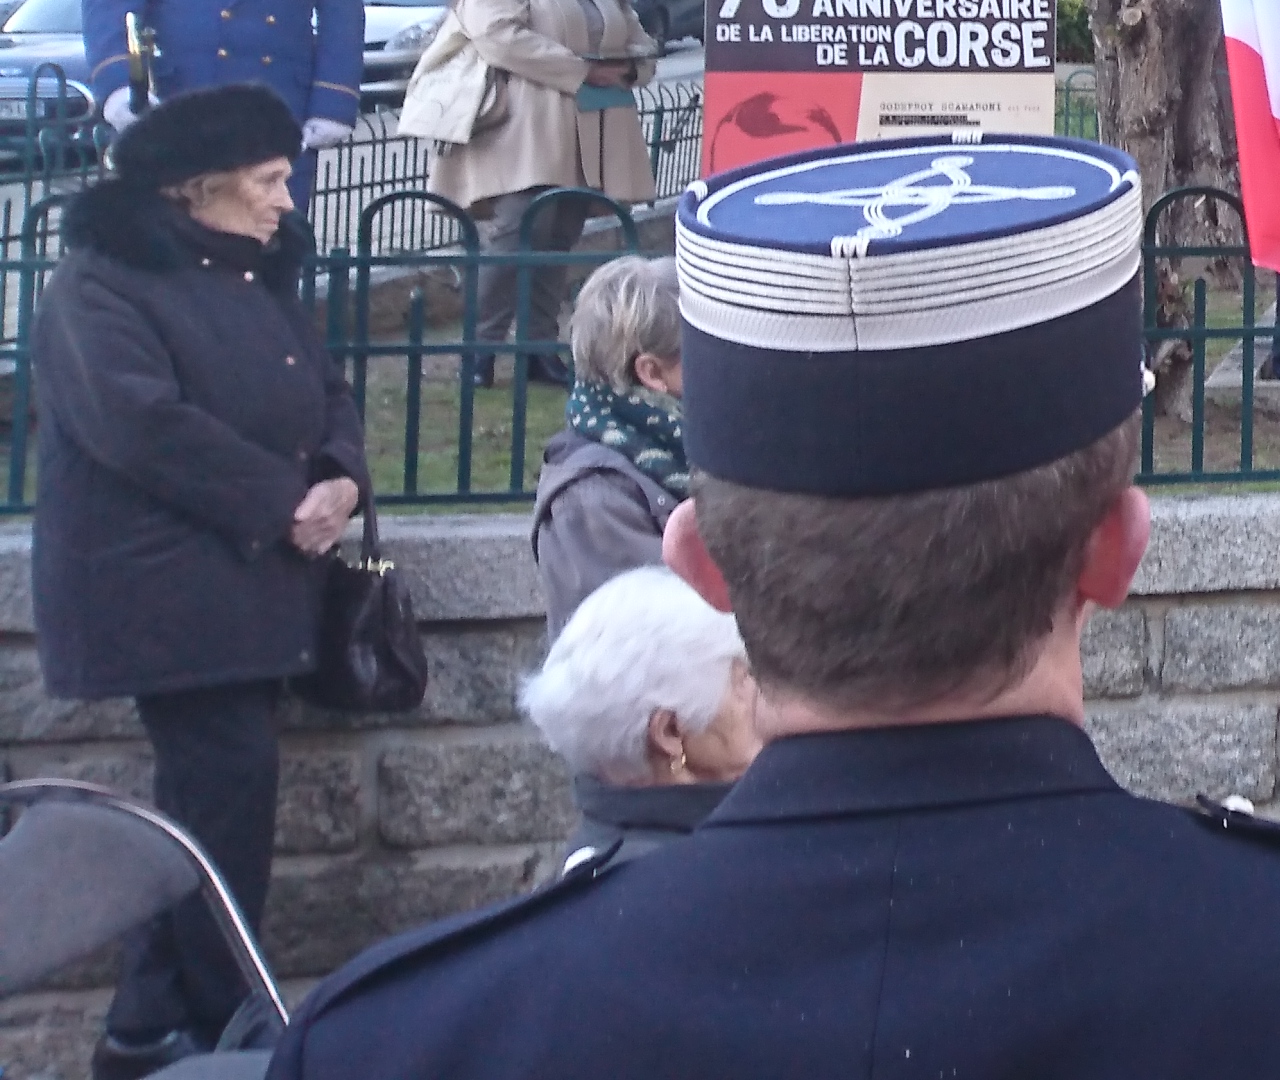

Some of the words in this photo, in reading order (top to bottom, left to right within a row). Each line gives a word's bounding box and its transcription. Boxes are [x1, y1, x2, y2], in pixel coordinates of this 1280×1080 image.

[716, 23, 742, 42] DE
[749, 24, 773, 42] LA
[781, 24, 892, 43] LIBERATION
[816, 43, 848, 66] DE
[858, 44, 890, 66] LA
[894, 19, 1051, 68] CORSE
